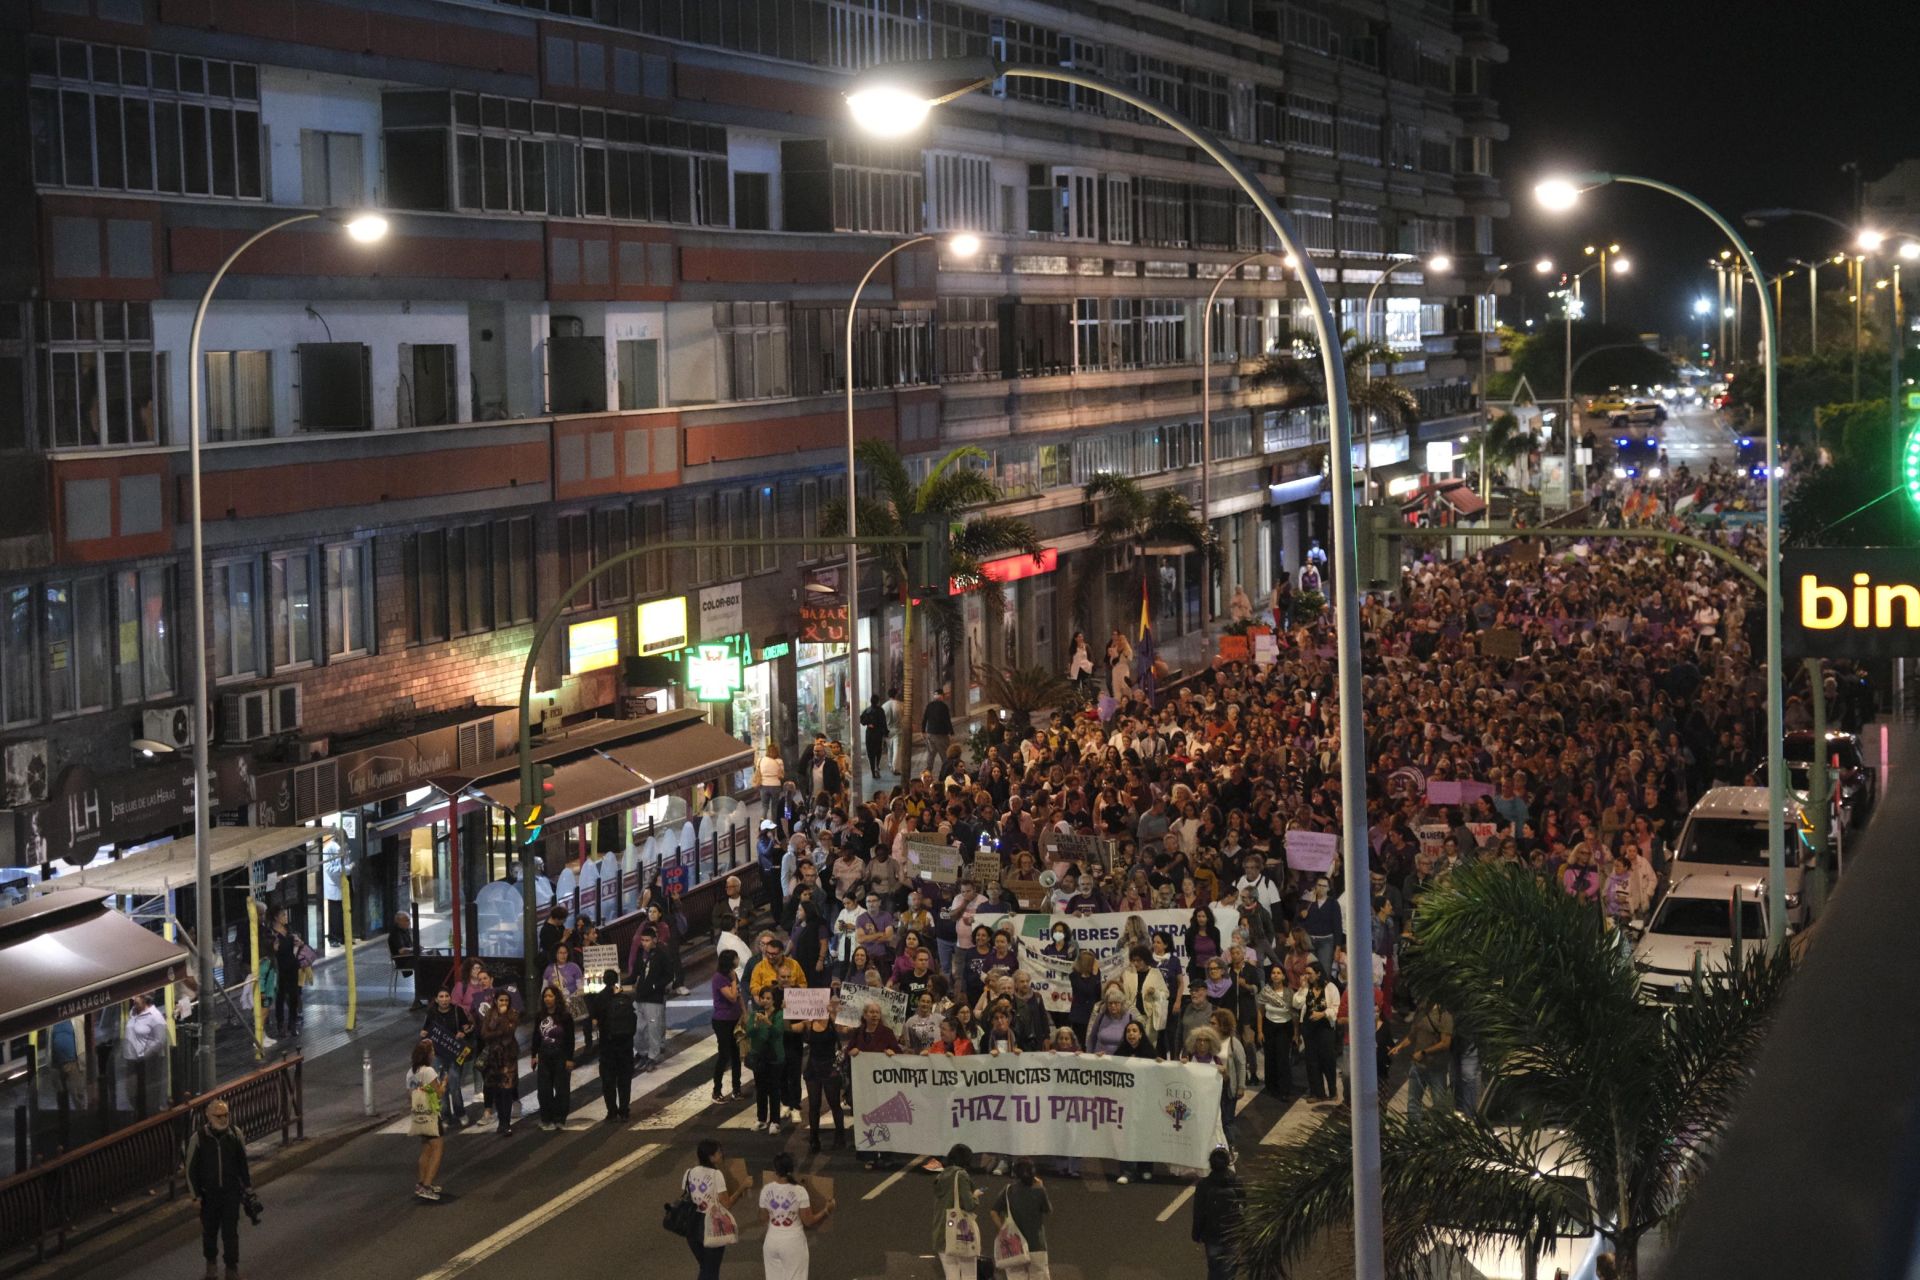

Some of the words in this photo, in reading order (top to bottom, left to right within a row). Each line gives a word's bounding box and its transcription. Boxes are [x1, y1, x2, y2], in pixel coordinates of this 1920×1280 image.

[69, 788, 100, 849] JLH
[57, 991, 111, 1018] TAMARAGUA
[873, 1068, 928, 1087] CONTRA
[932, 1069, 958, 1086] LAS
[959, 1068, 1051, 1087] VIOLENCIAS
[1054, 1068, 1135, 1088] MACHISTAS
[951, 1095, 1006, 1128] ¡HAZ
[1010, 1095, 1040, 1124] TU
[1048, 1095, 1124, 1131] PARTE!
